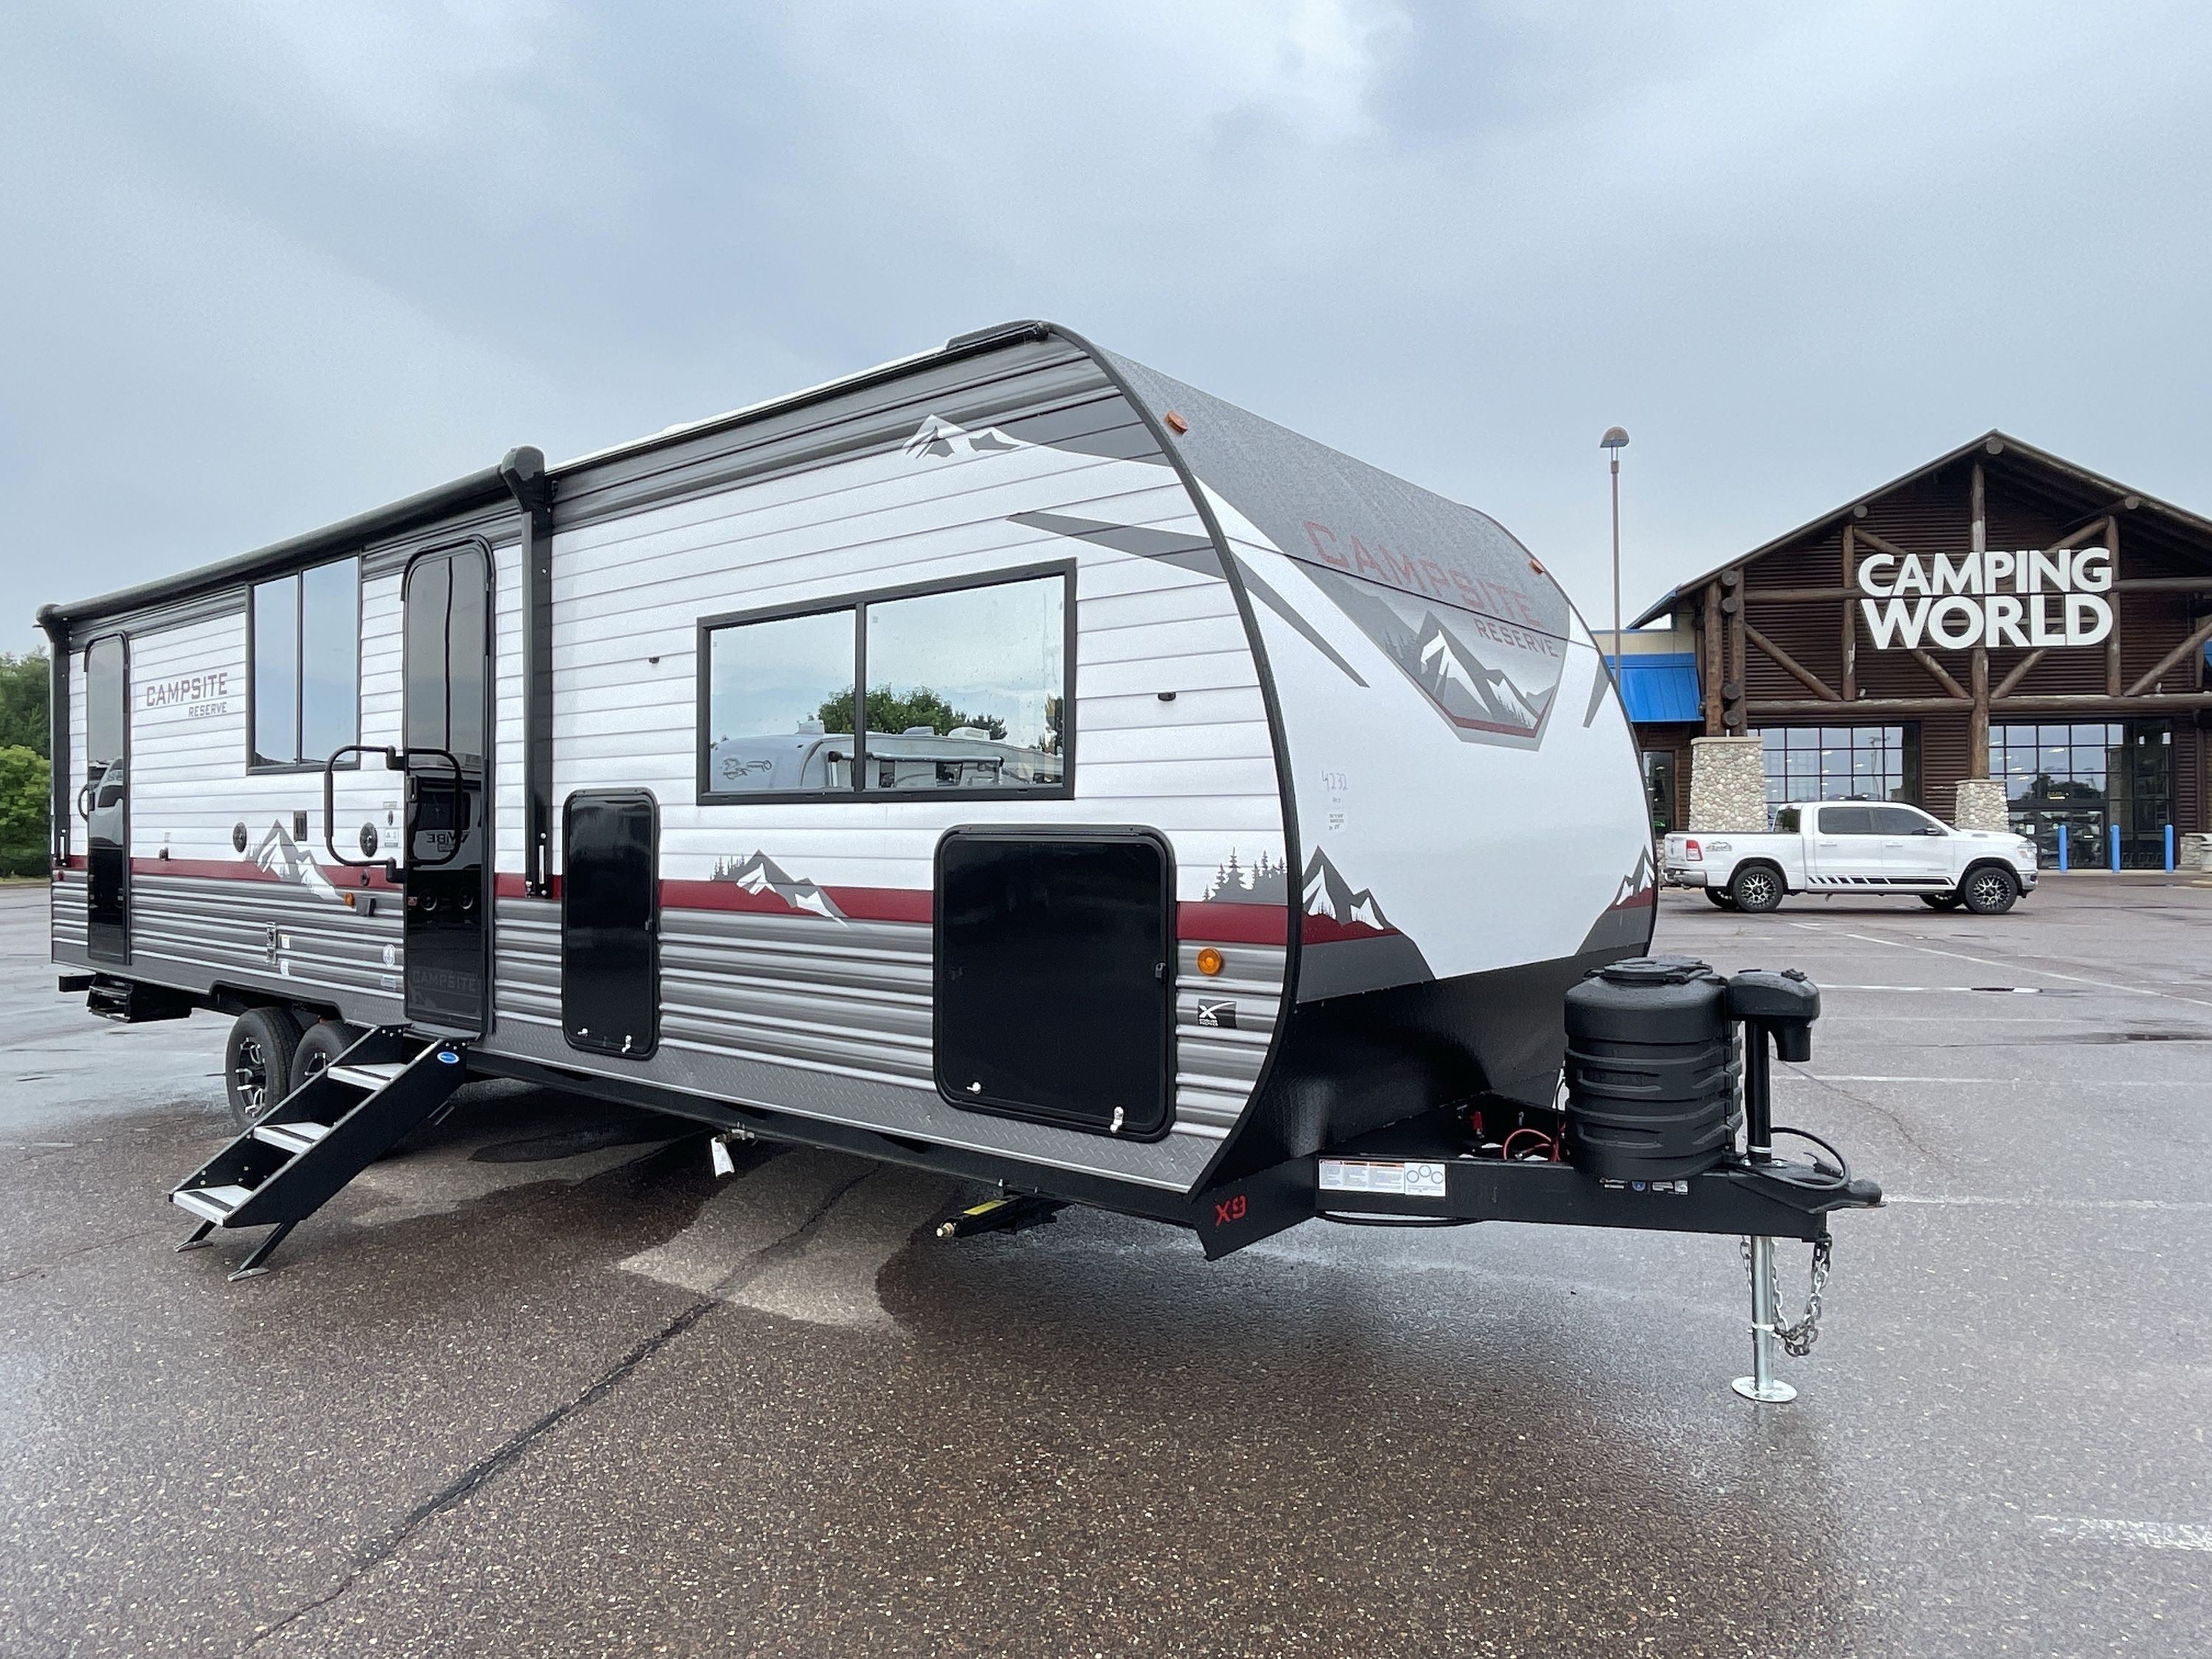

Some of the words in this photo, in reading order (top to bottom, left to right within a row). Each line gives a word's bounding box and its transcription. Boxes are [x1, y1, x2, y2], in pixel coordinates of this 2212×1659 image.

[1303, 520, 1543, 627] CAMPSITE
[1858, 547, 2112, 597] CAMPING
[1473, 618, 1559, 658] RESERVE
[1861, 594, 2113, 650] WORLD
[146, 672, 228, 707] CAMPSITE
[189, 702, 227, 717] RESERVE
[412, 970, 478, 992] CAMPSITE
